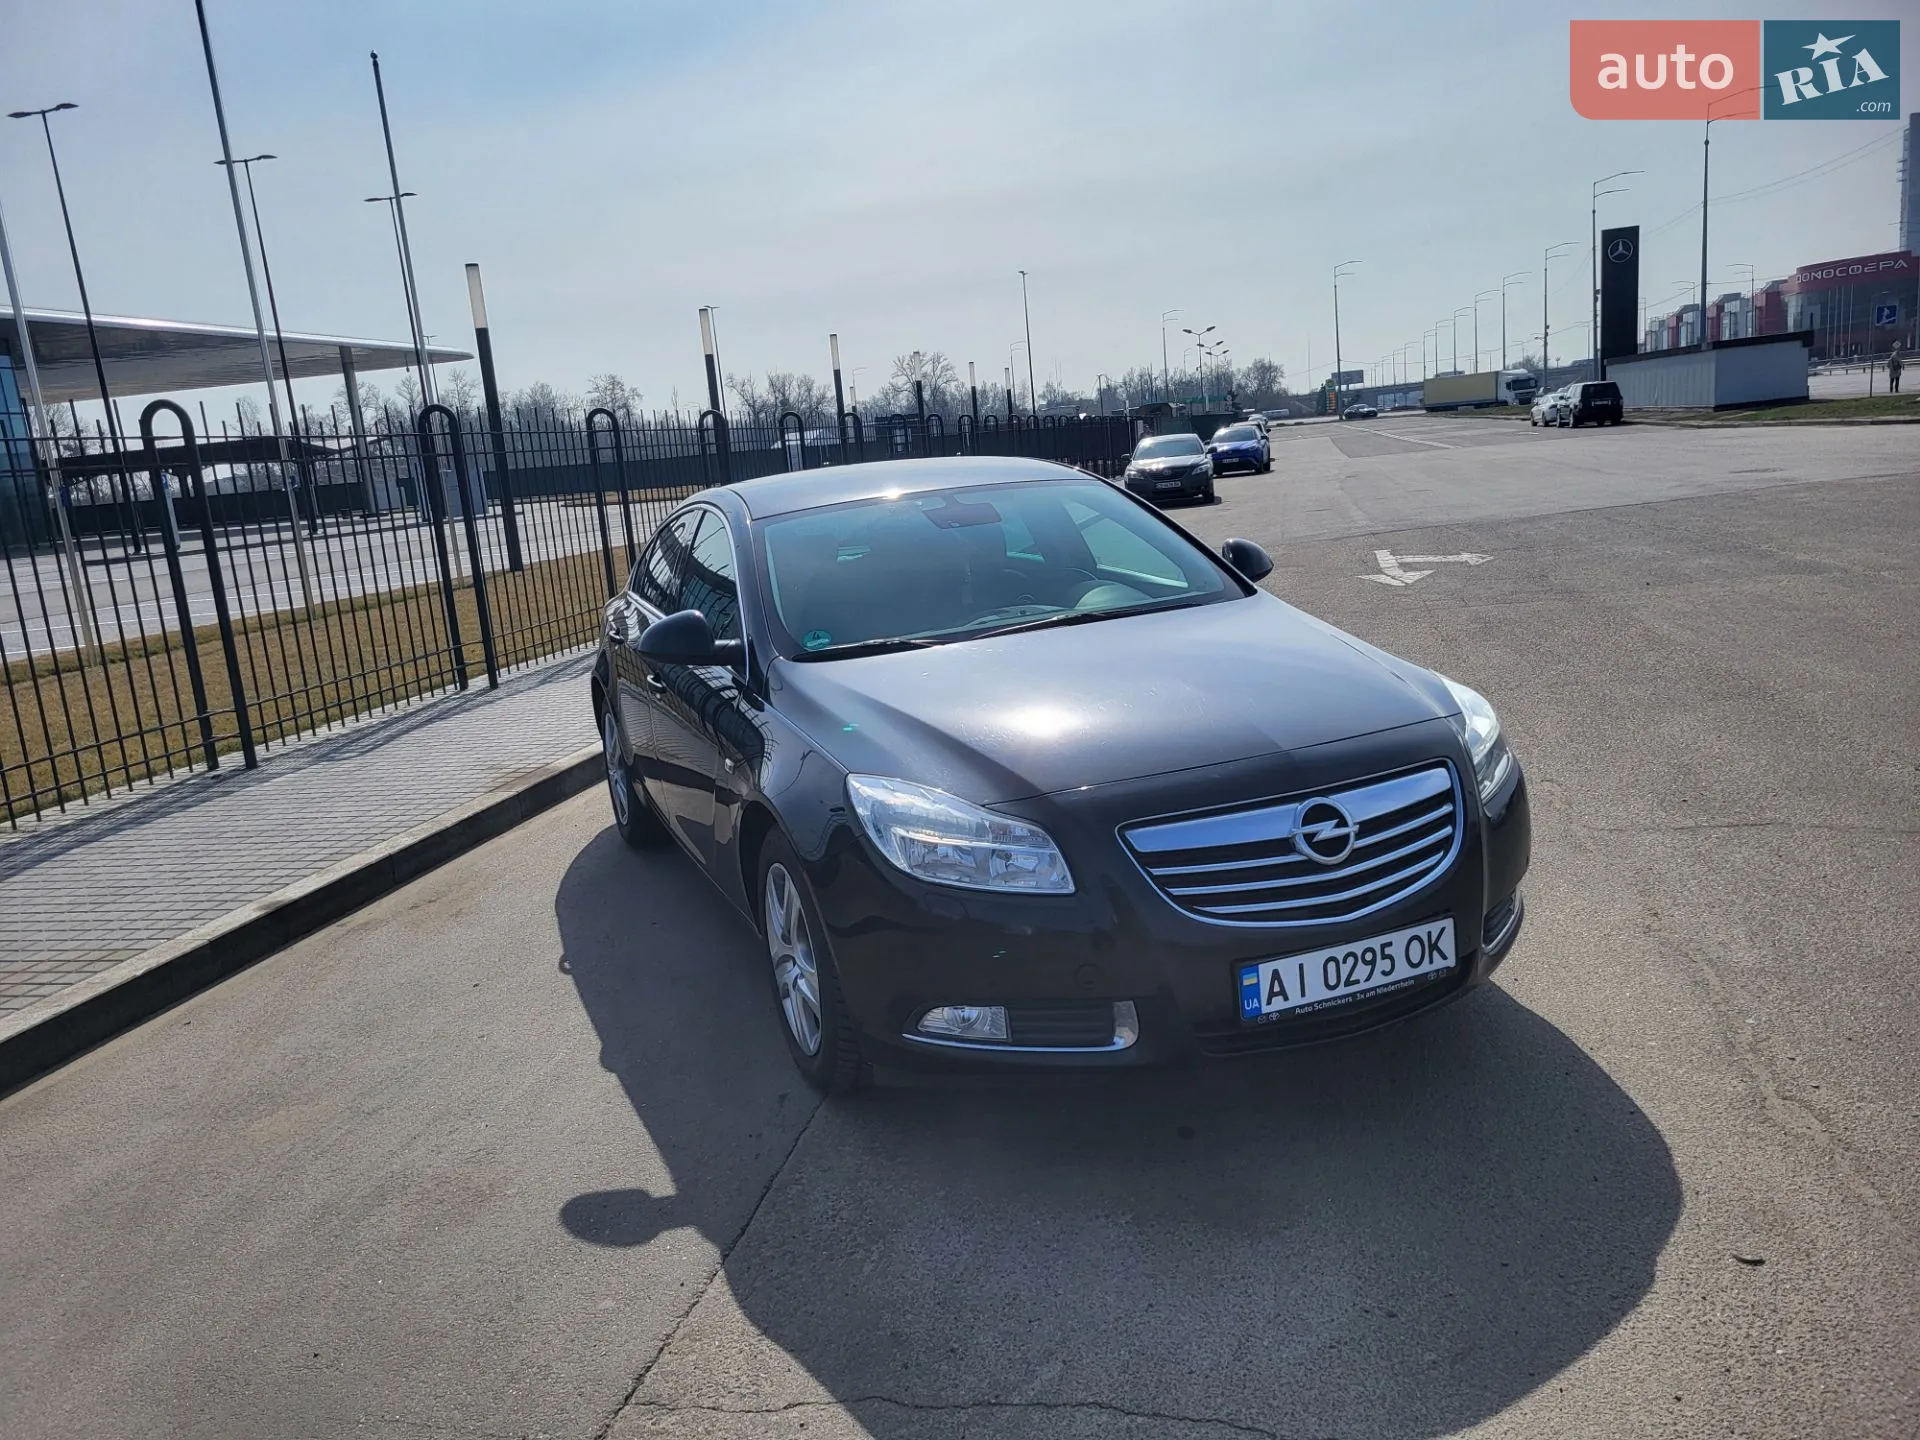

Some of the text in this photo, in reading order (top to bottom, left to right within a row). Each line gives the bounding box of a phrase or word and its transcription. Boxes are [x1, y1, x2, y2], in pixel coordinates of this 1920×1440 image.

[1266, 926, 1449, 1006] AI 0295 OK
[1244, 997, 1260, 1011] UA
[1295, 1004, 1313, 1015] Auto
[1314, 996, 1353, 1011] Schnickers
[1366, 989, 1376, 999] am
[1376, 979, 1415, 994] Niederrhein
